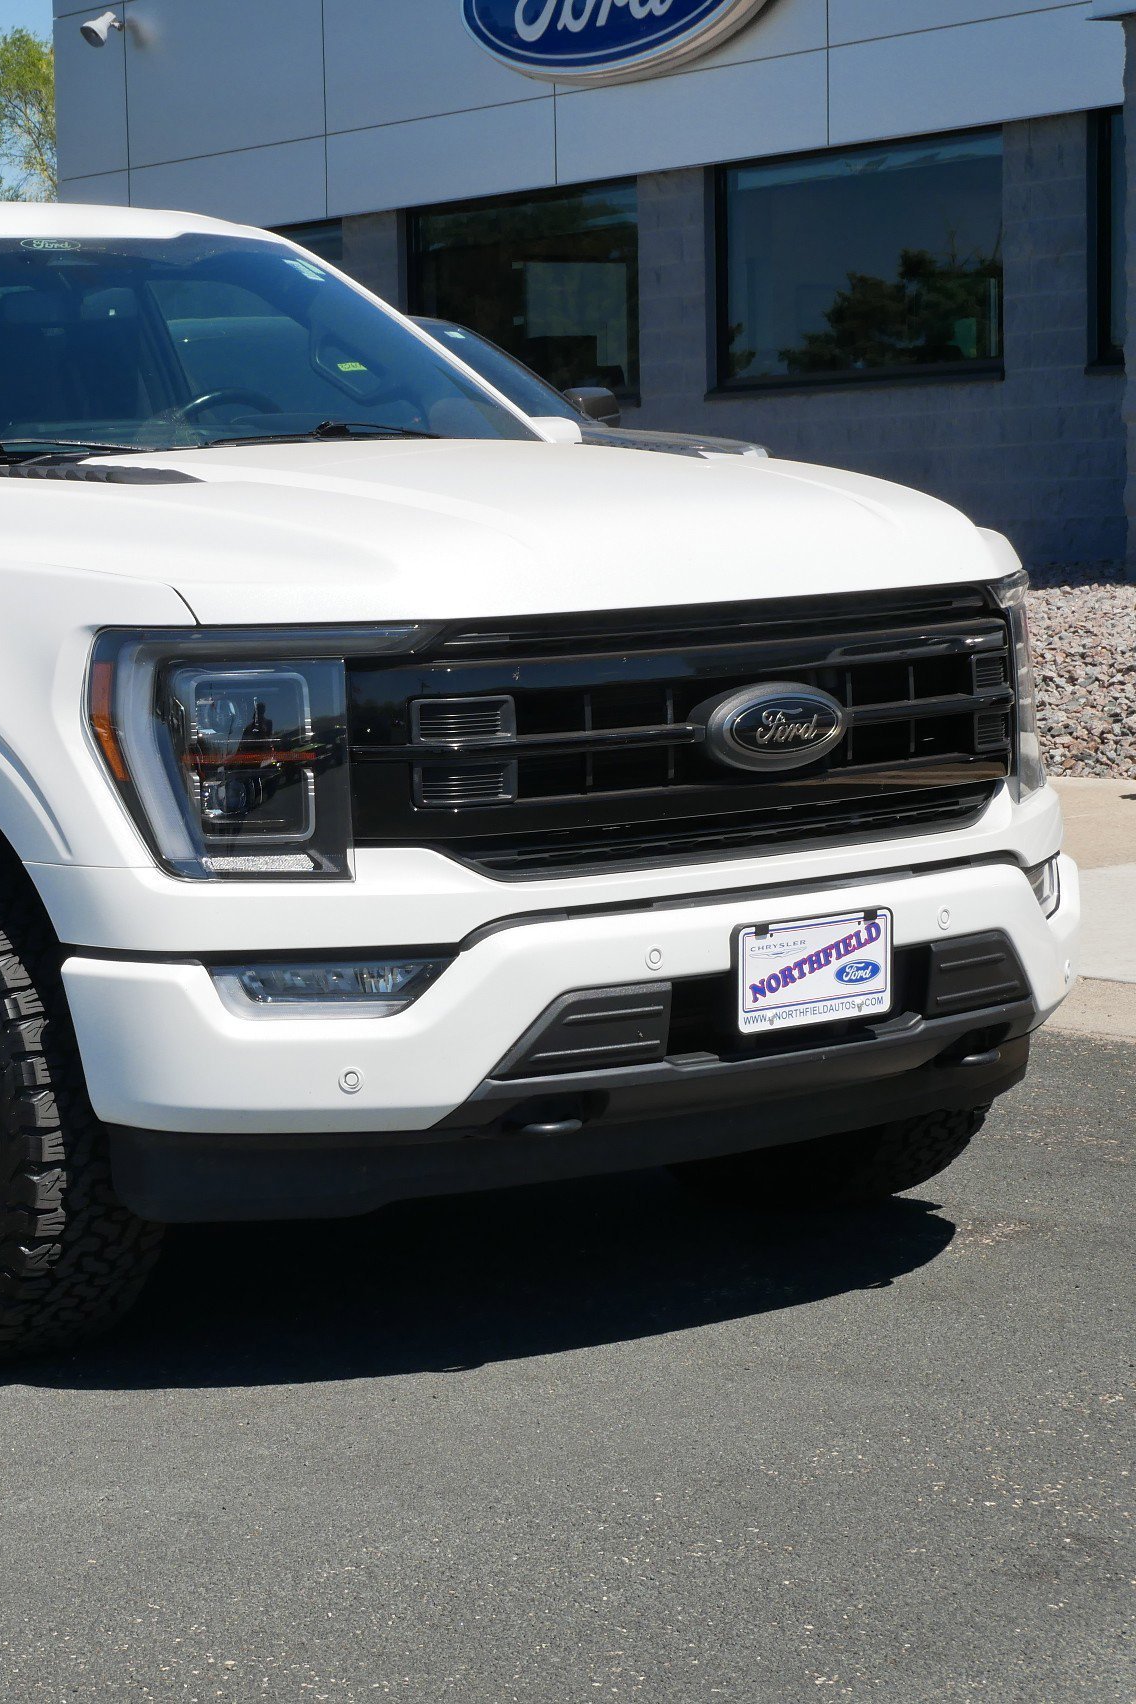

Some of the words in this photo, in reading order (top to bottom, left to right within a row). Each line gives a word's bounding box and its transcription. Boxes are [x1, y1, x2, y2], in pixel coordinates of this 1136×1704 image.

[33, 240, 71, 249] Ford
[756, 708, 818, 744] Ford
[750, 939, 806, 952] CHRYSLER
[749, 922, 881, 1003] NORTHFIELD
[843, 964, 872, 981] Ford
[743, 996, 884, 1026] WWW.NORTHFIELDAUTOSCOM
